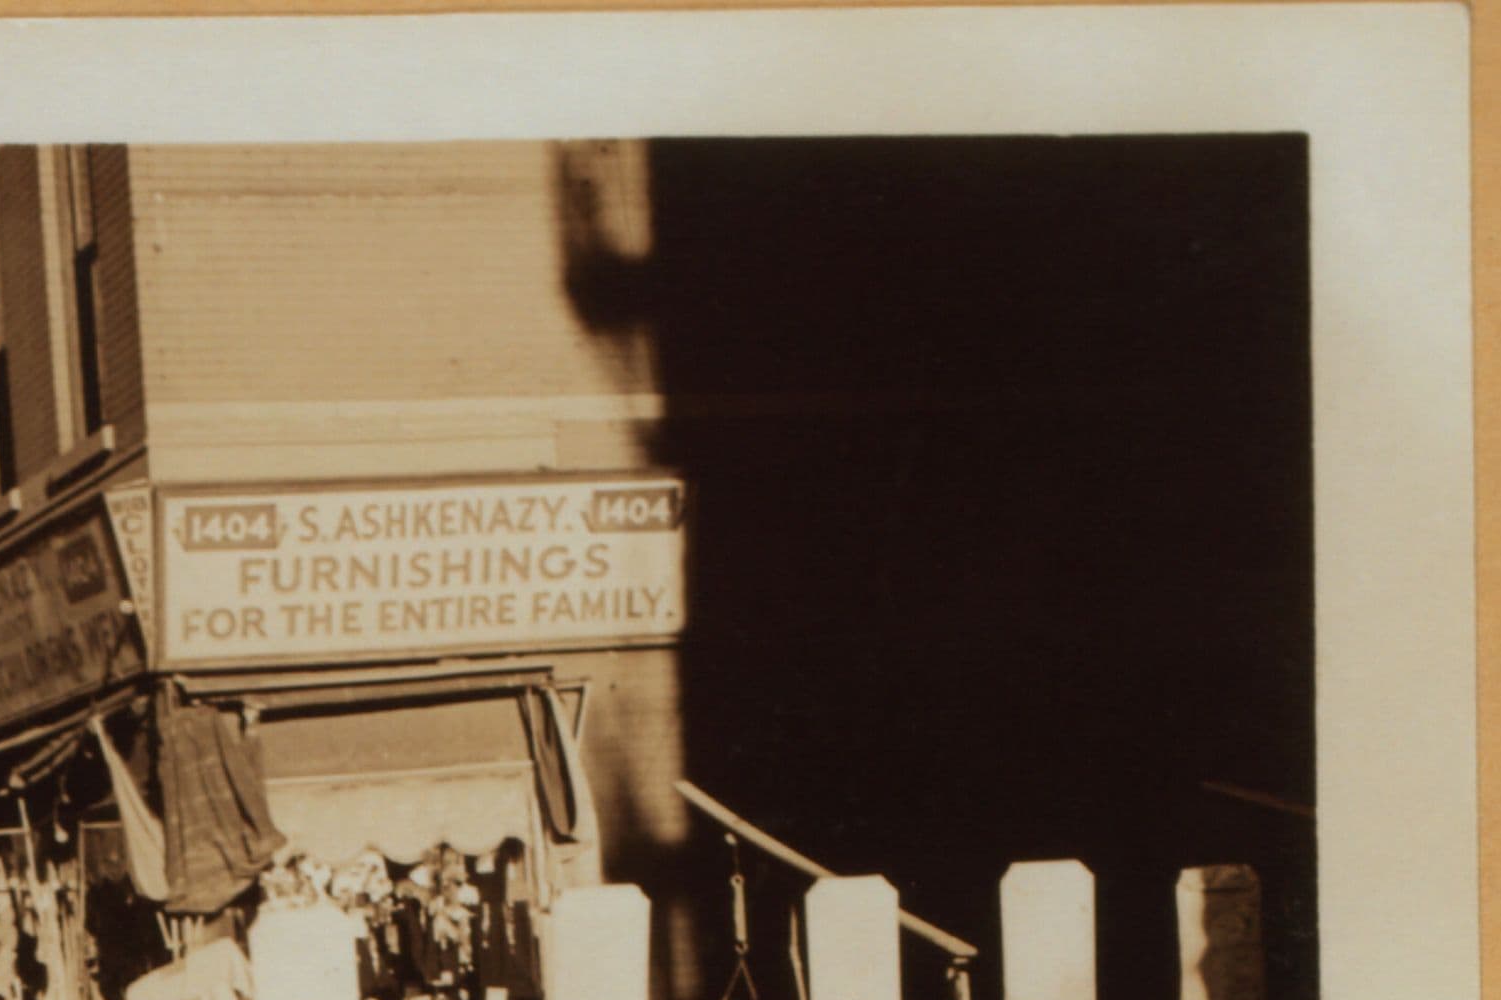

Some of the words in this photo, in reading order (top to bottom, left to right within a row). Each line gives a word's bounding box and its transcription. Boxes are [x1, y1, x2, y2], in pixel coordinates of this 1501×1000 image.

[192, 511, 272, 545] 1404
[601, 494, 671, 527] 1404
[239, 543, 611, 596] FURNISHINGS
[181, 605, 268, 643] FOR
[278, 600, 364, 638] THE
[379, 593, 517, 634] ENTIRE
